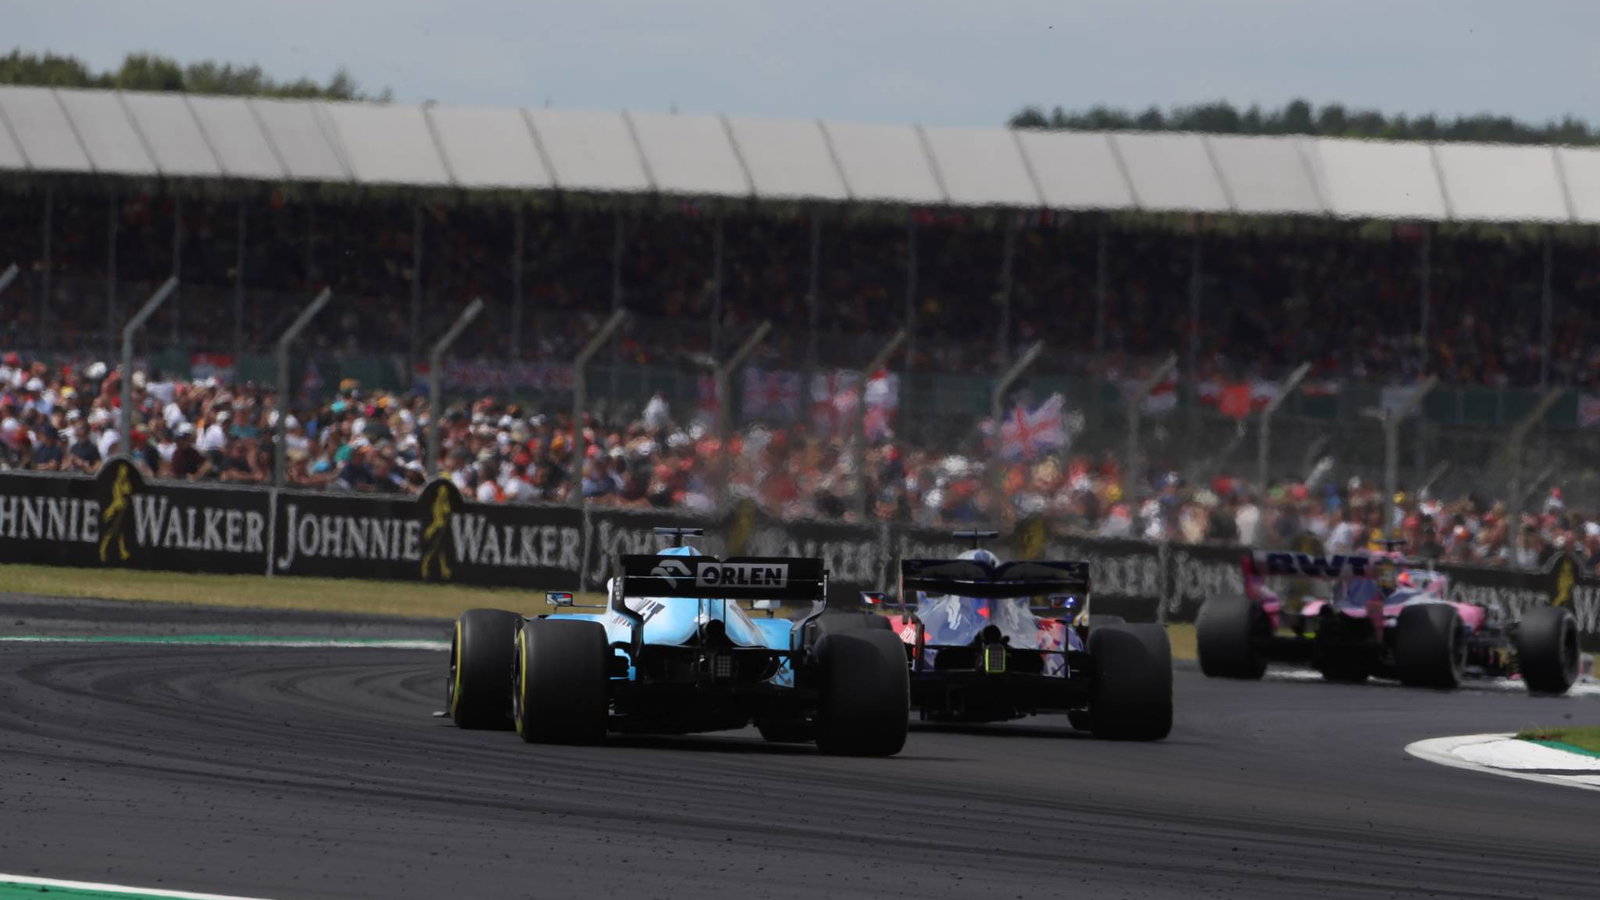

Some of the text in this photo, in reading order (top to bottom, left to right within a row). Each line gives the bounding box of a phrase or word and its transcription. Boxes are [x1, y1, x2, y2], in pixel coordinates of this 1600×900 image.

[131, 494, 265, 552] WALKER
[278, 503, 422, 570] JOHNNIE
[451, 513, 581, 571] WALKER
[702, 566, 782, 585] ORLEN
[1266, 552, 1369, 576] BWT
